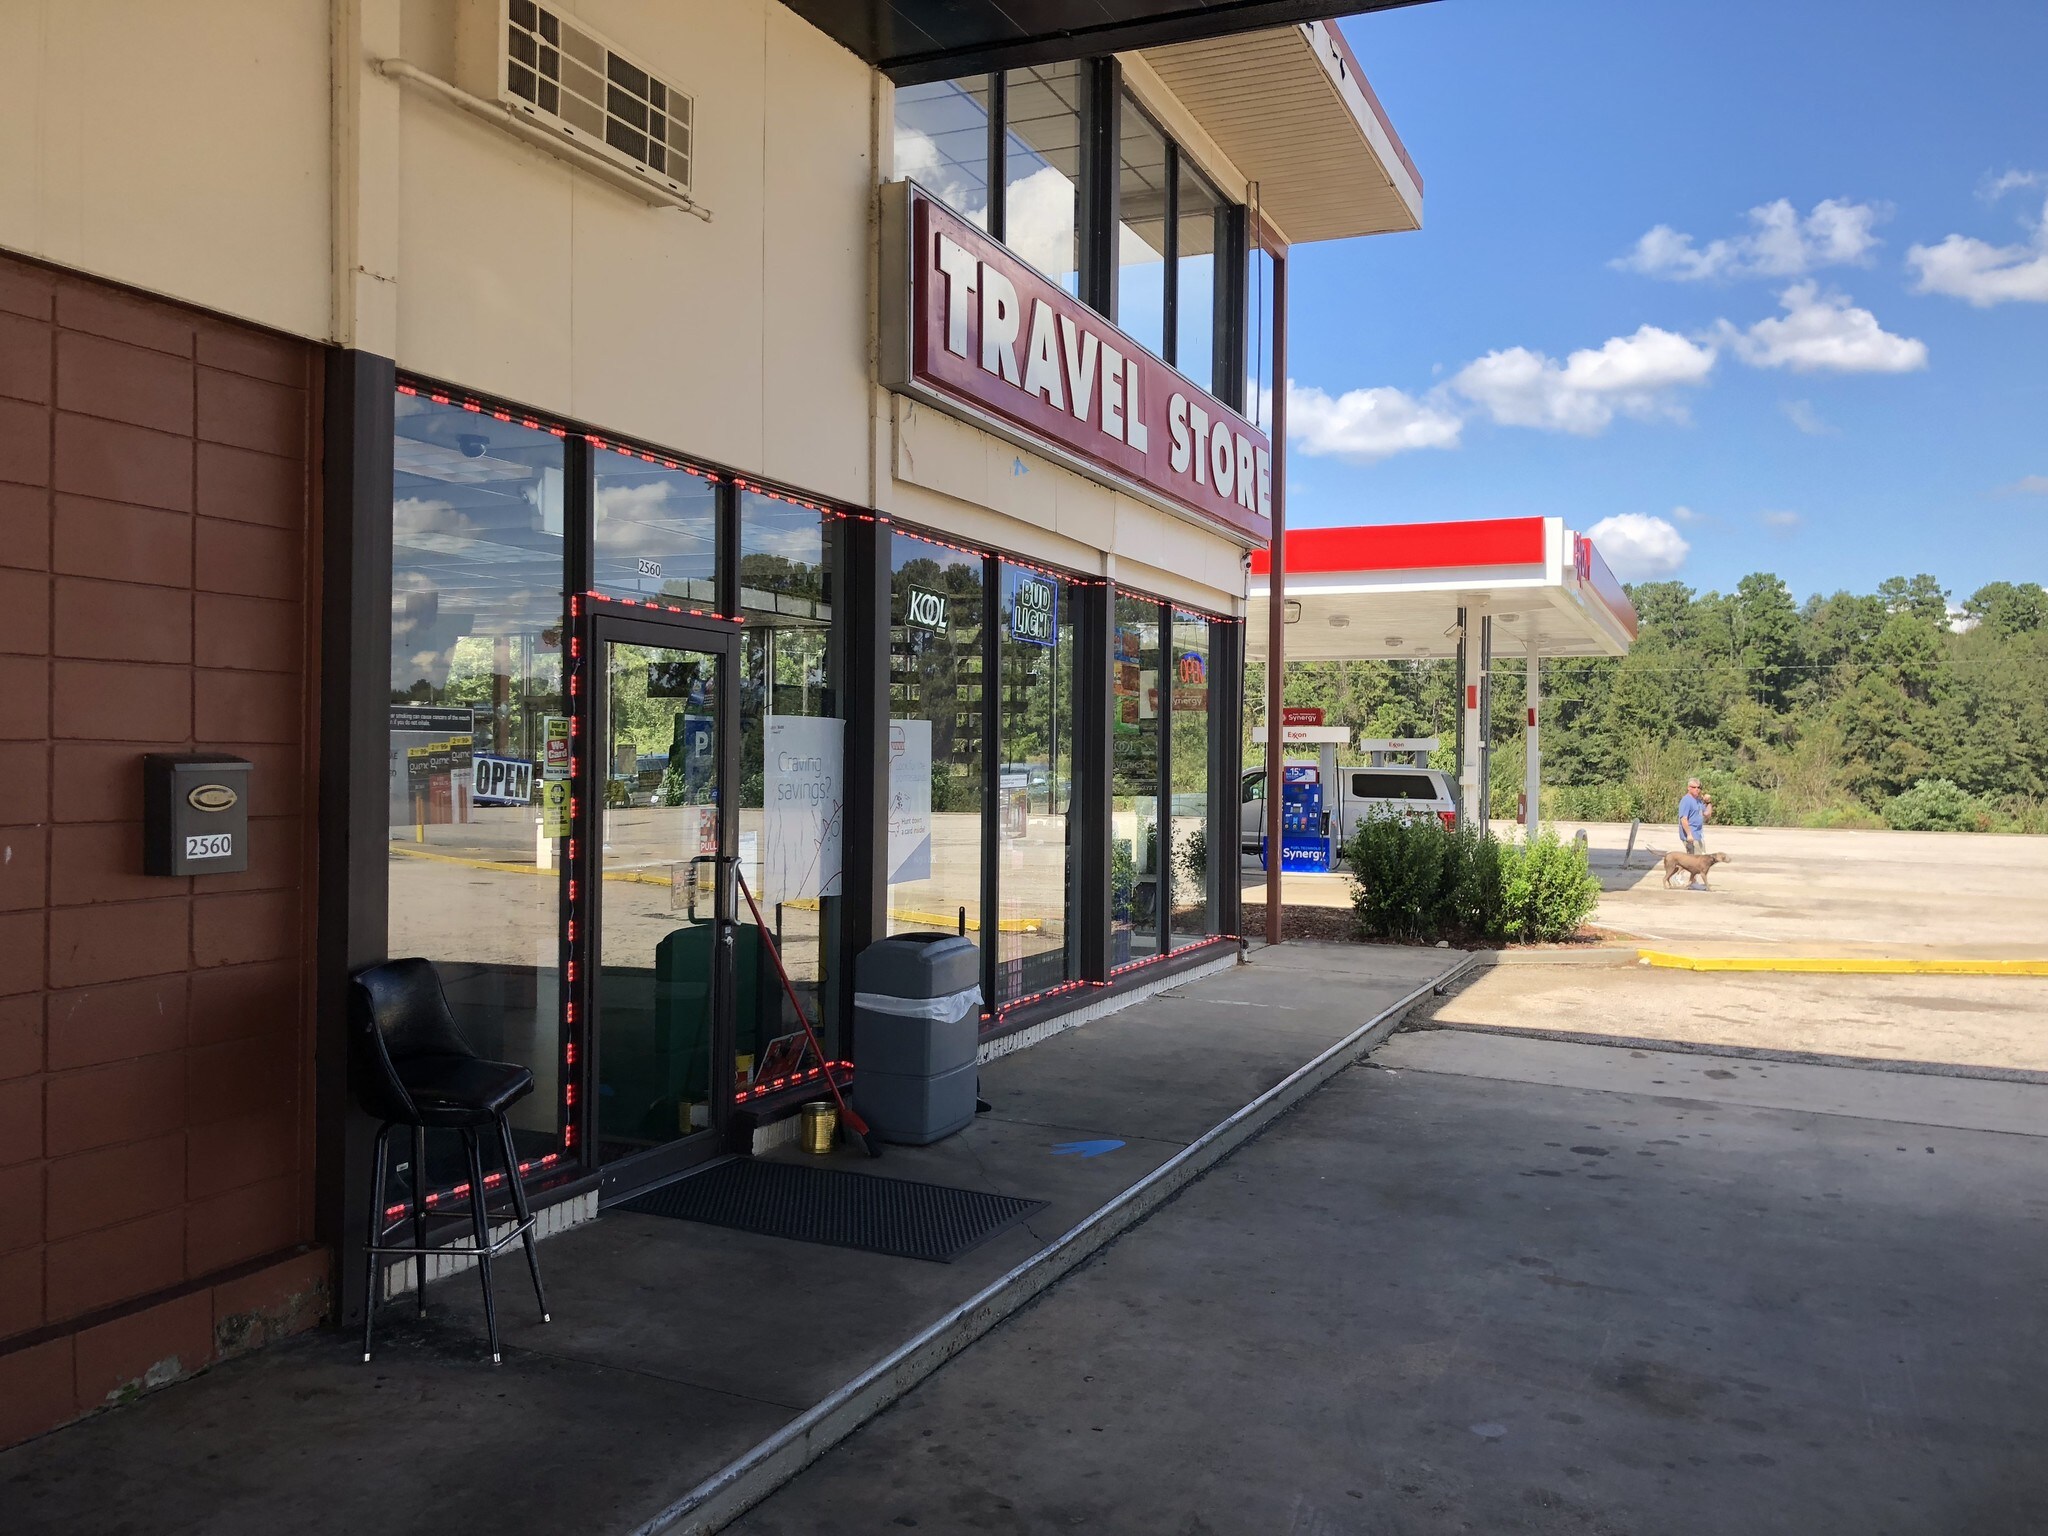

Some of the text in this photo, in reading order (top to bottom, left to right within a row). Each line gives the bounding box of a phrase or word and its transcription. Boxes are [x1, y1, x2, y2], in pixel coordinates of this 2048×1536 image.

[934, 231, 1271, 521] TRAVEL STORE
[639, 560, 661, 577] 2560
[1022, 578, 1051, 612] BUD
[909, 590, 948, 628] KOOL
[1014, 605, 1054, 640] LIGHT
[1180, 659, 1205, 684] OPEN
[1172, 697, 1202, 706] ynergy
[1288, 713, 1317, 722] Synergy
[1287, 731, 1307, 740] Exxon
[551, 741, 564, 750] We
[1388, 741, 1405, 749] Exxon
[451, 751, 471, 763] game
[549, 749, 568, 759] Card
[430, 757, 449, 770] game
[777, 751, 822, 779] Craving
[475, 759, 529, 799] OPEN
[777, 776, 832, 807] savings?
[188, 836, 231, 856] 2560
[700, 842, 718, 851] PULL
[1283, 847, 1326, 862] Synergy
